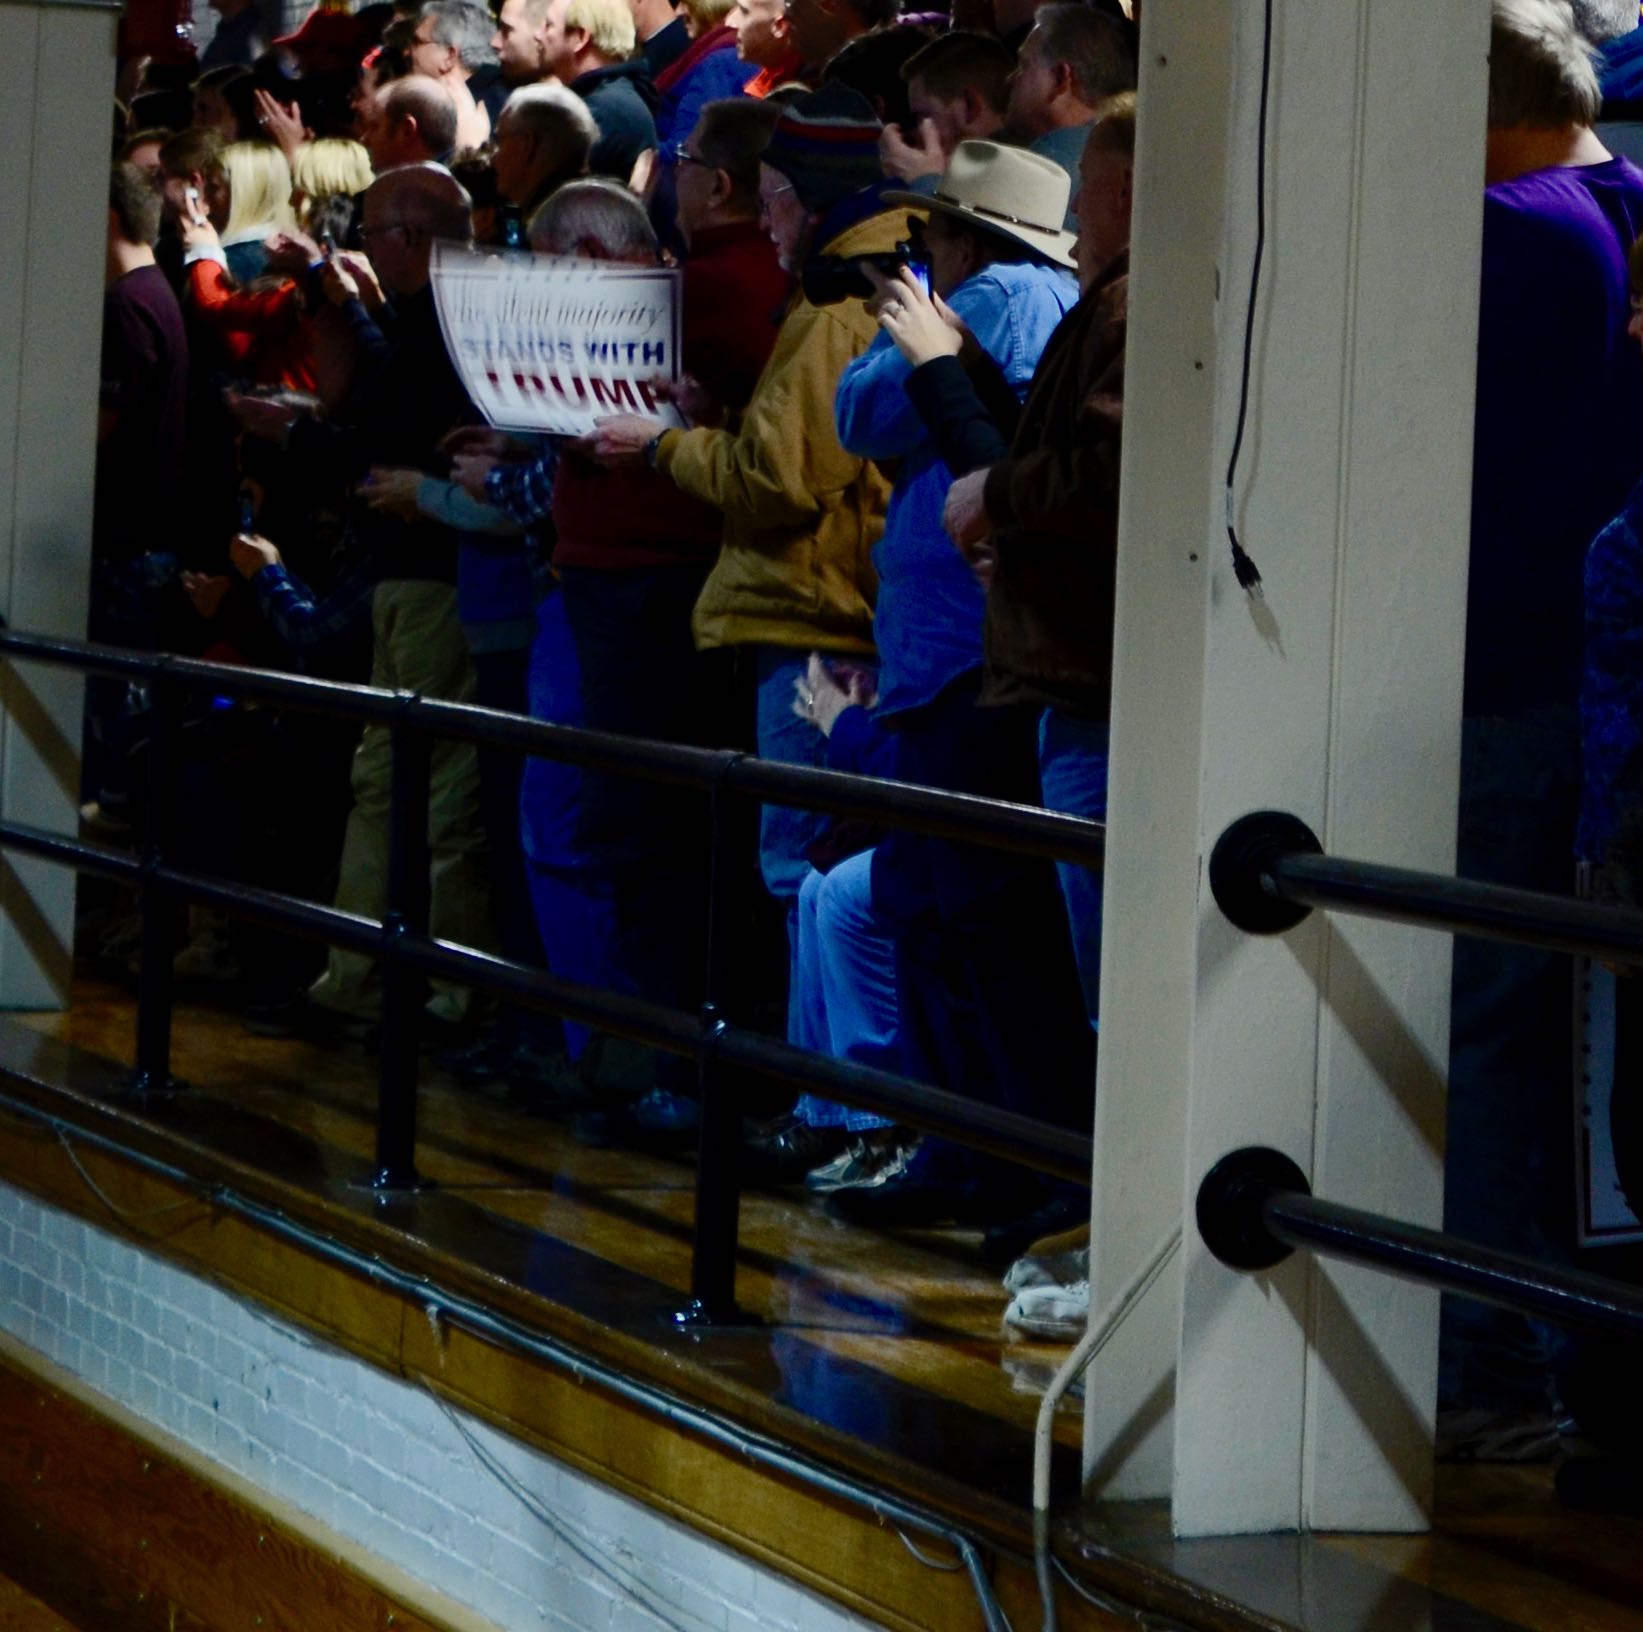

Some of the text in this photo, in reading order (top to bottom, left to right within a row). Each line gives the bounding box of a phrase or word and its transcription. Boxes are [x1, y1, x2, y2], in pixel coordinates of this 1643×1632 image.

[557, 300, 665, 336] majority
[460, 335, 665, 367] STANDS WITH
[480, 371, 662, 416] TRUMP
